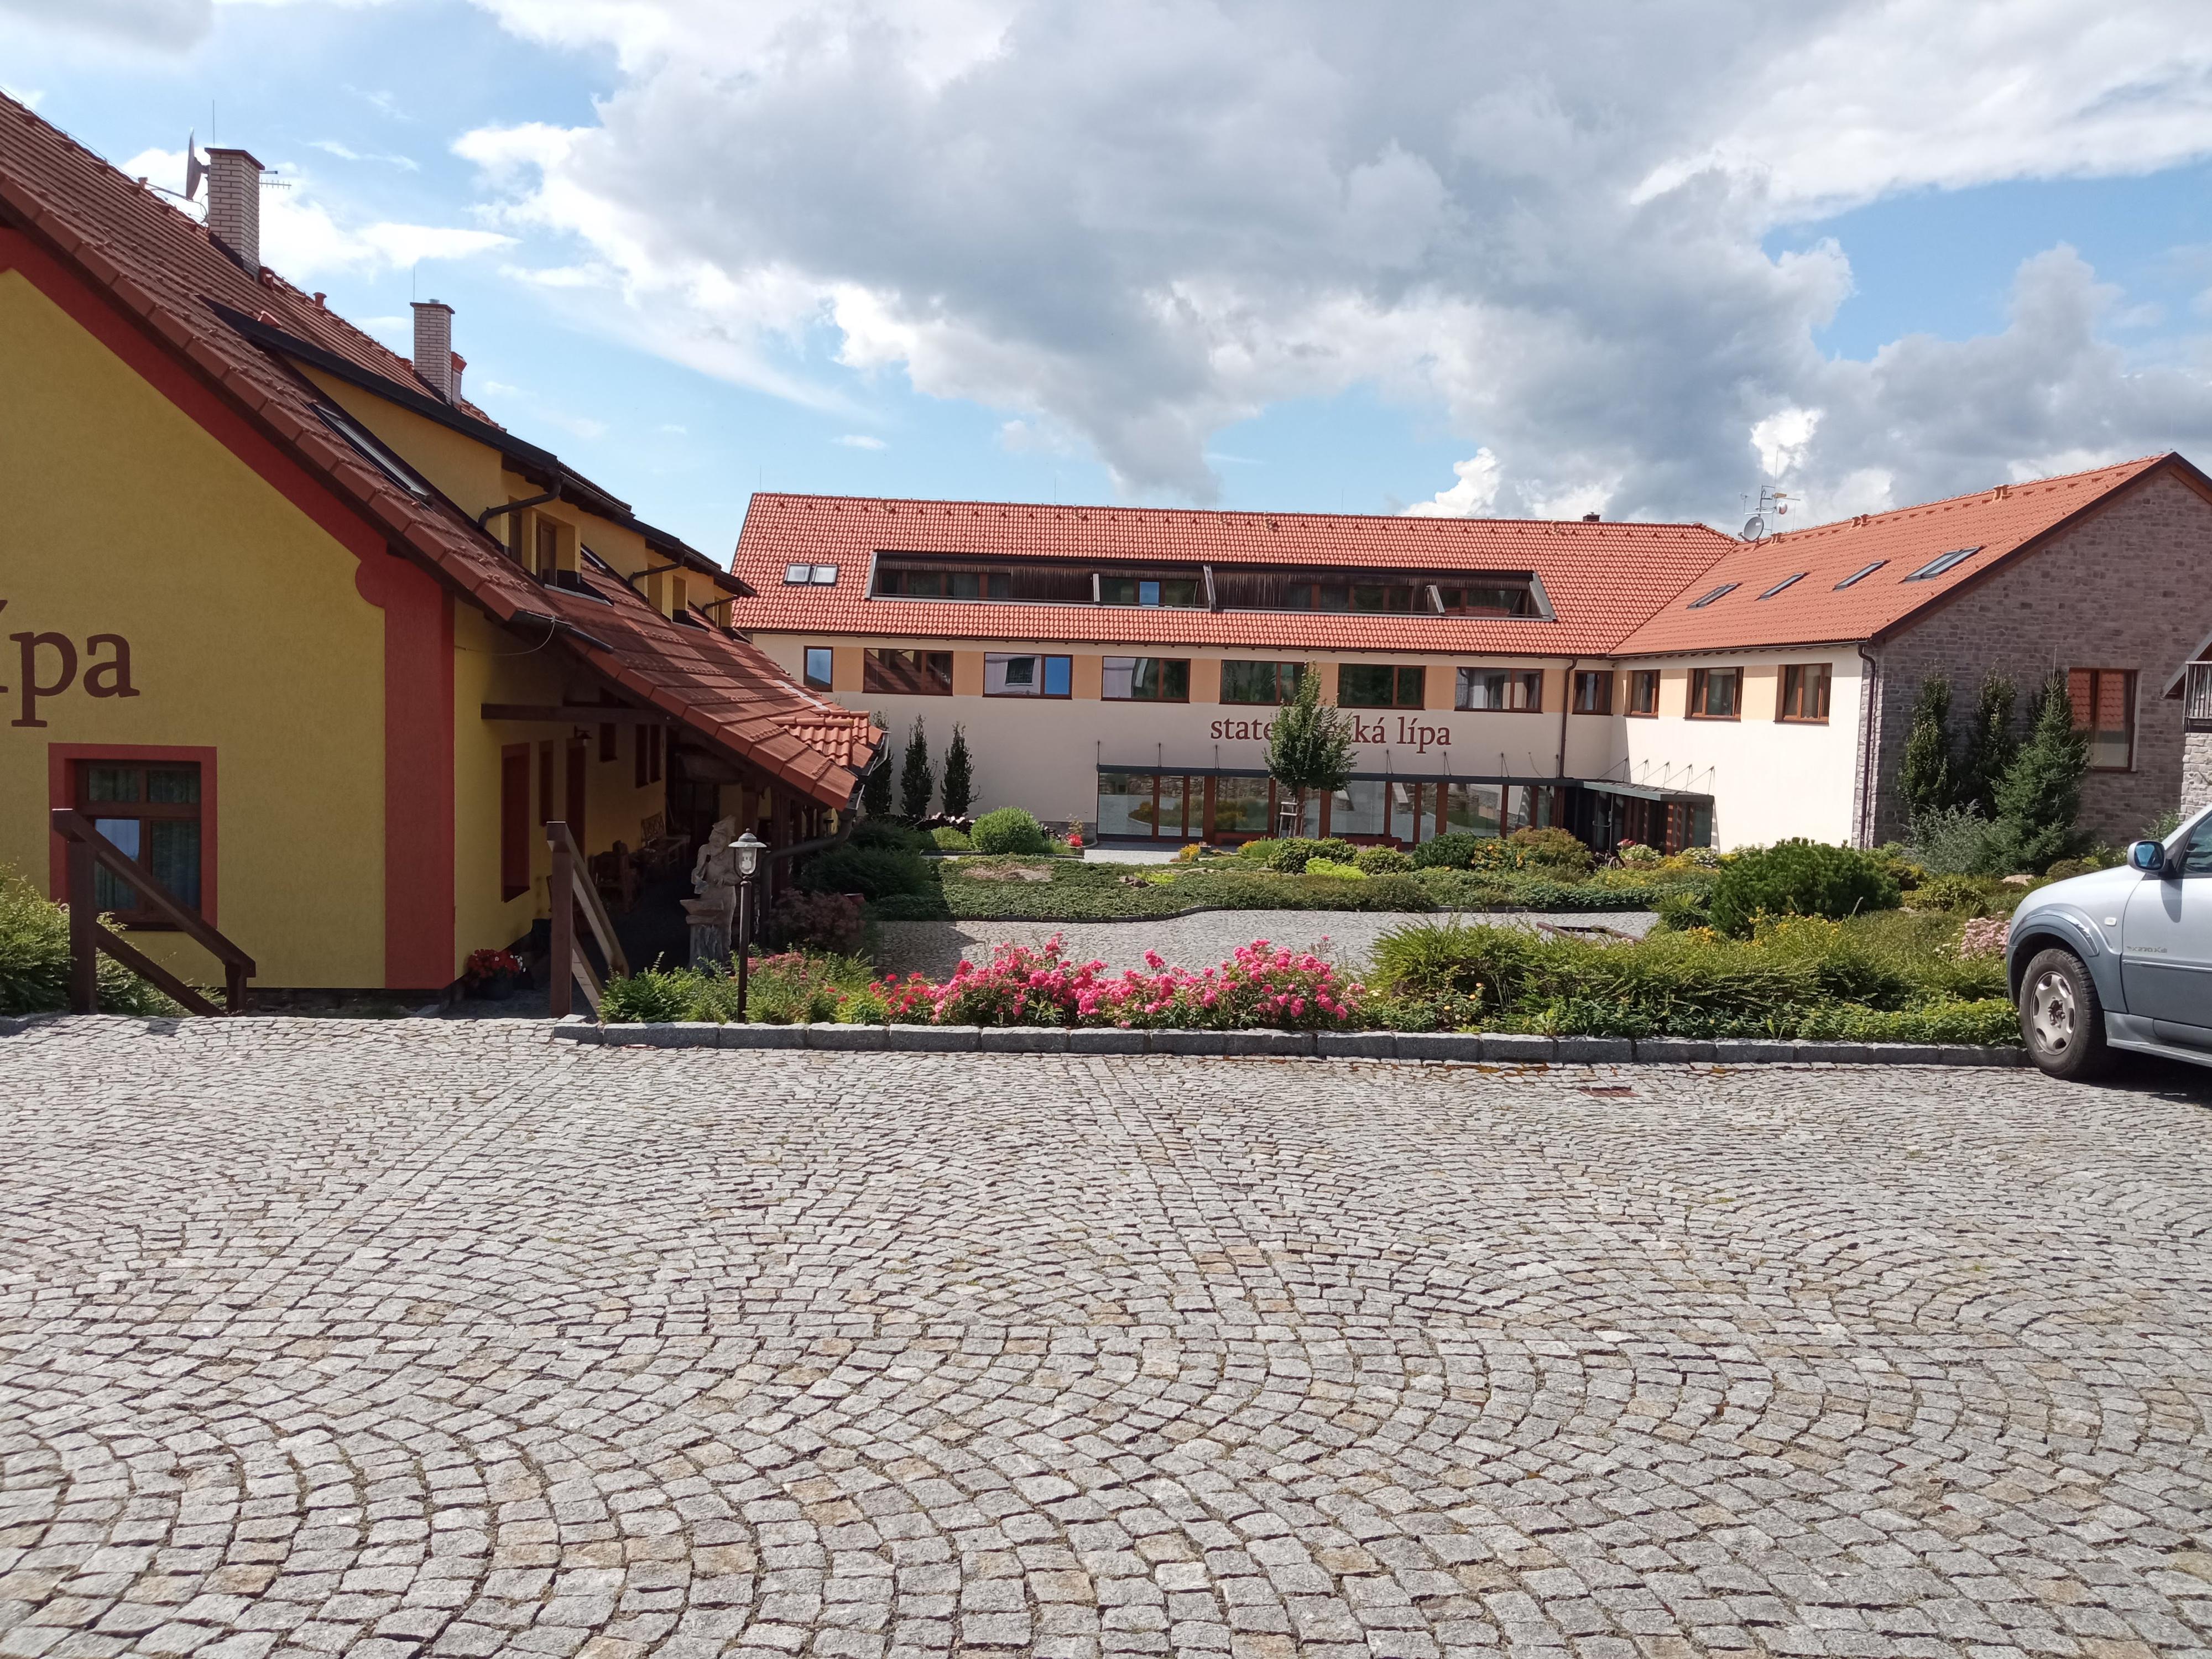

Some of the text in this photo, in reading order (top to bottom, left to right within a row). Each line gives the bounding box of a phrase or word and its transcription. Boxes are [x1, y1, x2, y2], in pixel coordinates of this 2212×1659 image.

[0, 599, 140, 727] pa
[1210, 717, 1297, 742] state
[1396, 717, 1452, 754] lípa
